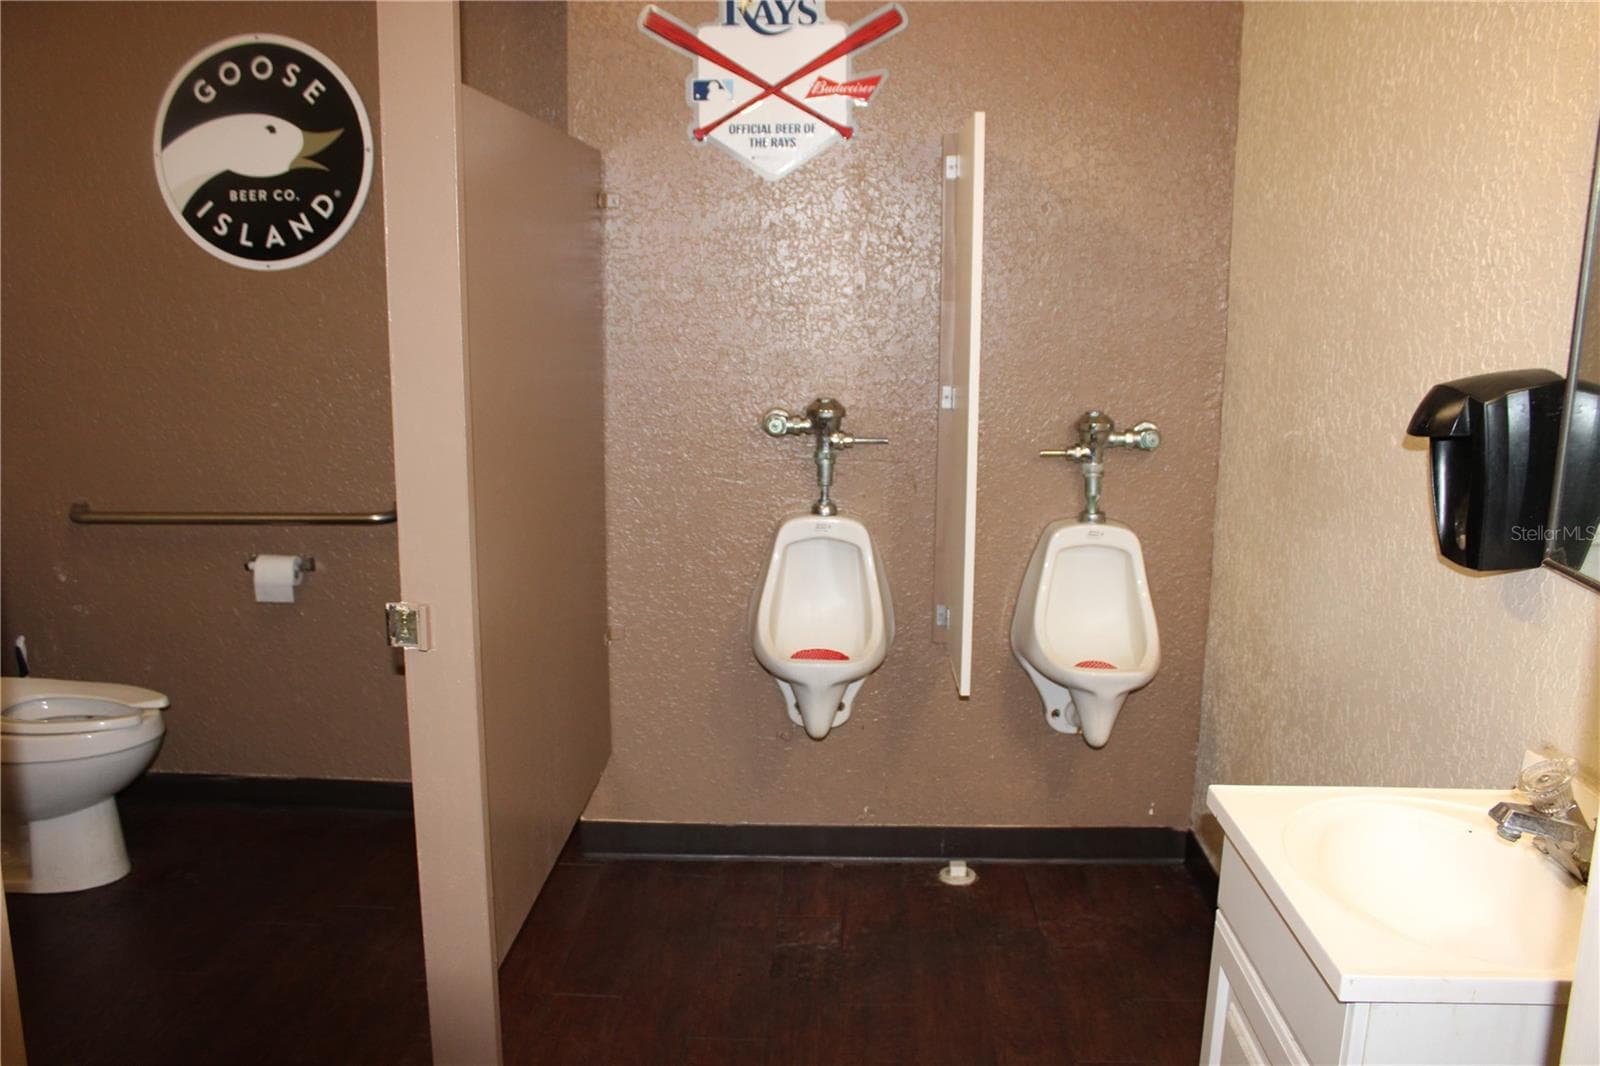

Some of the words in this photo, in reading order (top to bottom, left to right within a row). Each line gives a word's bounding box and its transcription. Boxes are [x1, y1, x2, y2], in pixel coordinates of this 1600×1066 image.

[722, 0, 818, 35] RAYS
[193, 56, 327, 105] GOOSE
[811, 79, 876, 96] Budweiser
[728, 123, 772, 135] OFFICIAL
[775, 123, 801, 134] BEER
[803, 123, 816, 134] OF
[749, 137, 768, 148] THE
[770, 137, 797, 148] RAYS
[229, 190, 268, 202] BEER
[273, 189, 300, 202] CO.
[196, 194, 335, 248] ISLAND
